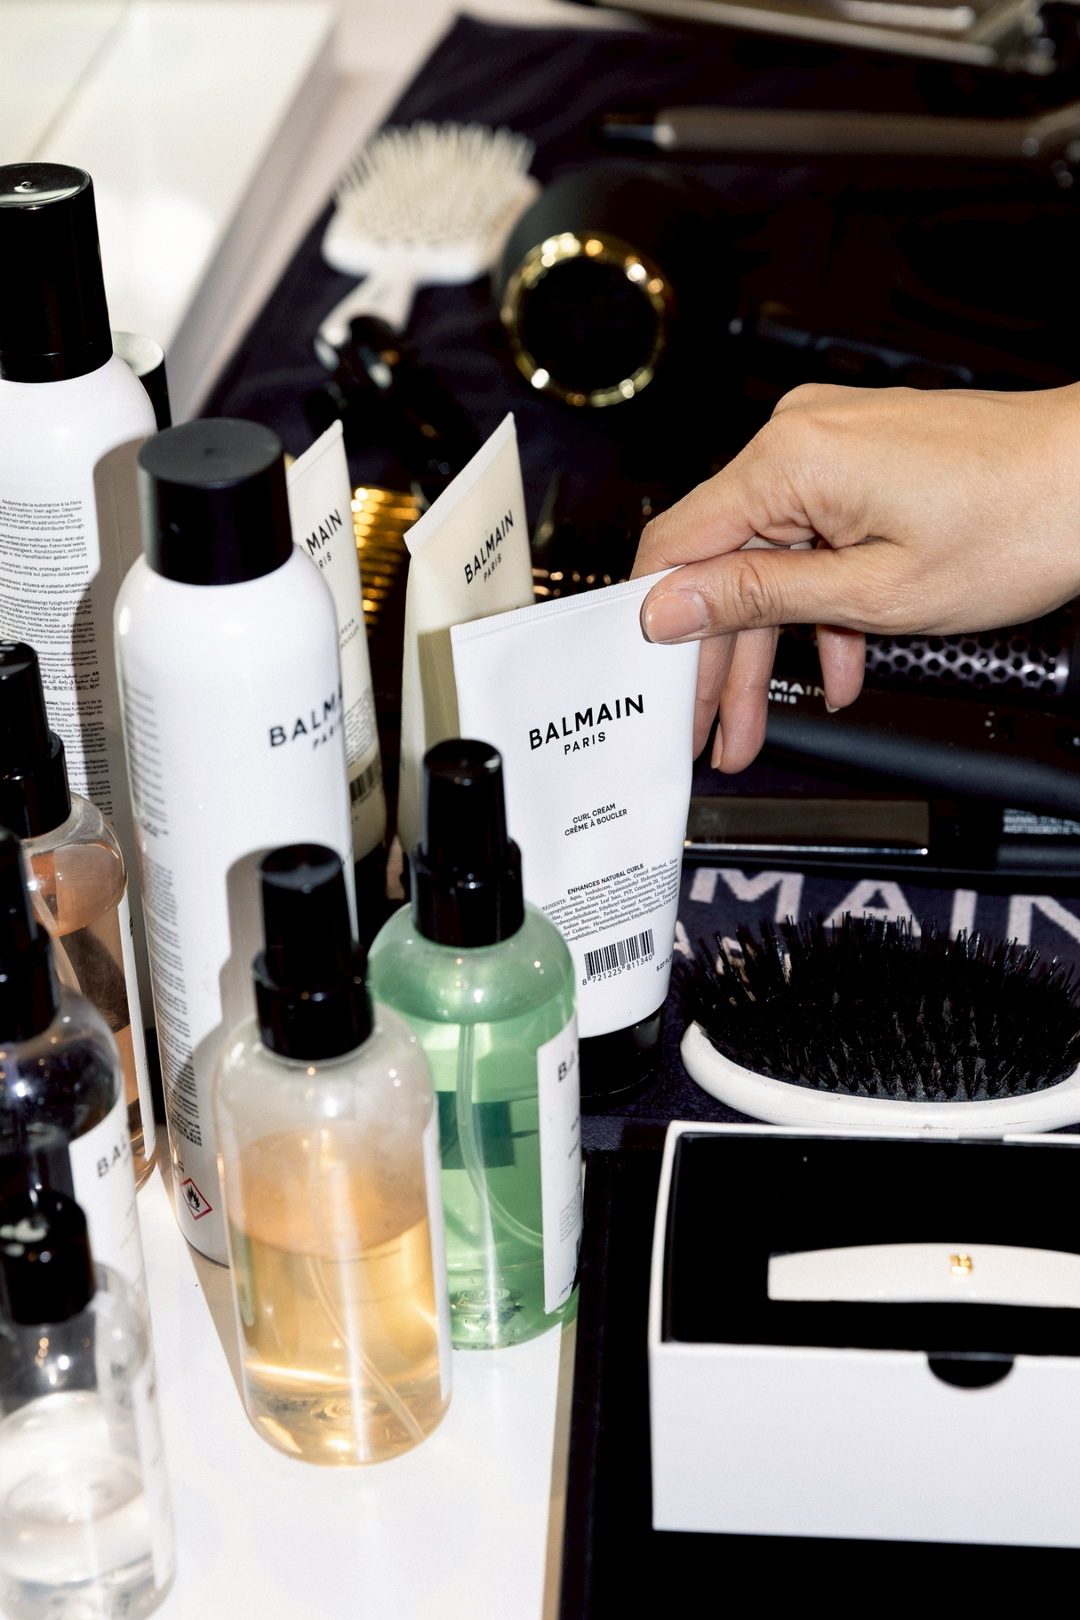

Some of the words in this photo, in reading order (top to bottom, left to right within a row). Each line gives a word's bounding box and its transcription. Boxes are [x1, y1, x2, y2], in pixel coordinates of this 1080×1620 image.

[299, 508, 342, 556] MAIN
[464, 509, 514, 585] BALMAIN
[318, 552, 332, 570] RIS
[483, 552, 502, 582] PARIS
[768, 691, 798, 704] ARIS
[770, 678, 826, 698] MAIN
[269, 682, 343, 748] BALM
[529, 694, 644, 751] BALMAIN
[564, 732, 606, 756] PARIS
[564, 822, 590, 836] CRÈME
[590, 818, 596, 828] À
[596, 808, 628, 826] BOUCLER
[572, 812, 592, 824] CURL
[592, 803, 616, 817] CREAM
[568, 880, 600, 896] ENHANCES
[601, 870, 626, 884] NATURAL
[626, 863, 644, 875] CURLS
[689, 867, 1080, 948] MAIN
[582, 978, 588, 986] 8
[592, 967, 622, 983] 721225
[626, 953, 653, 970] 811340
